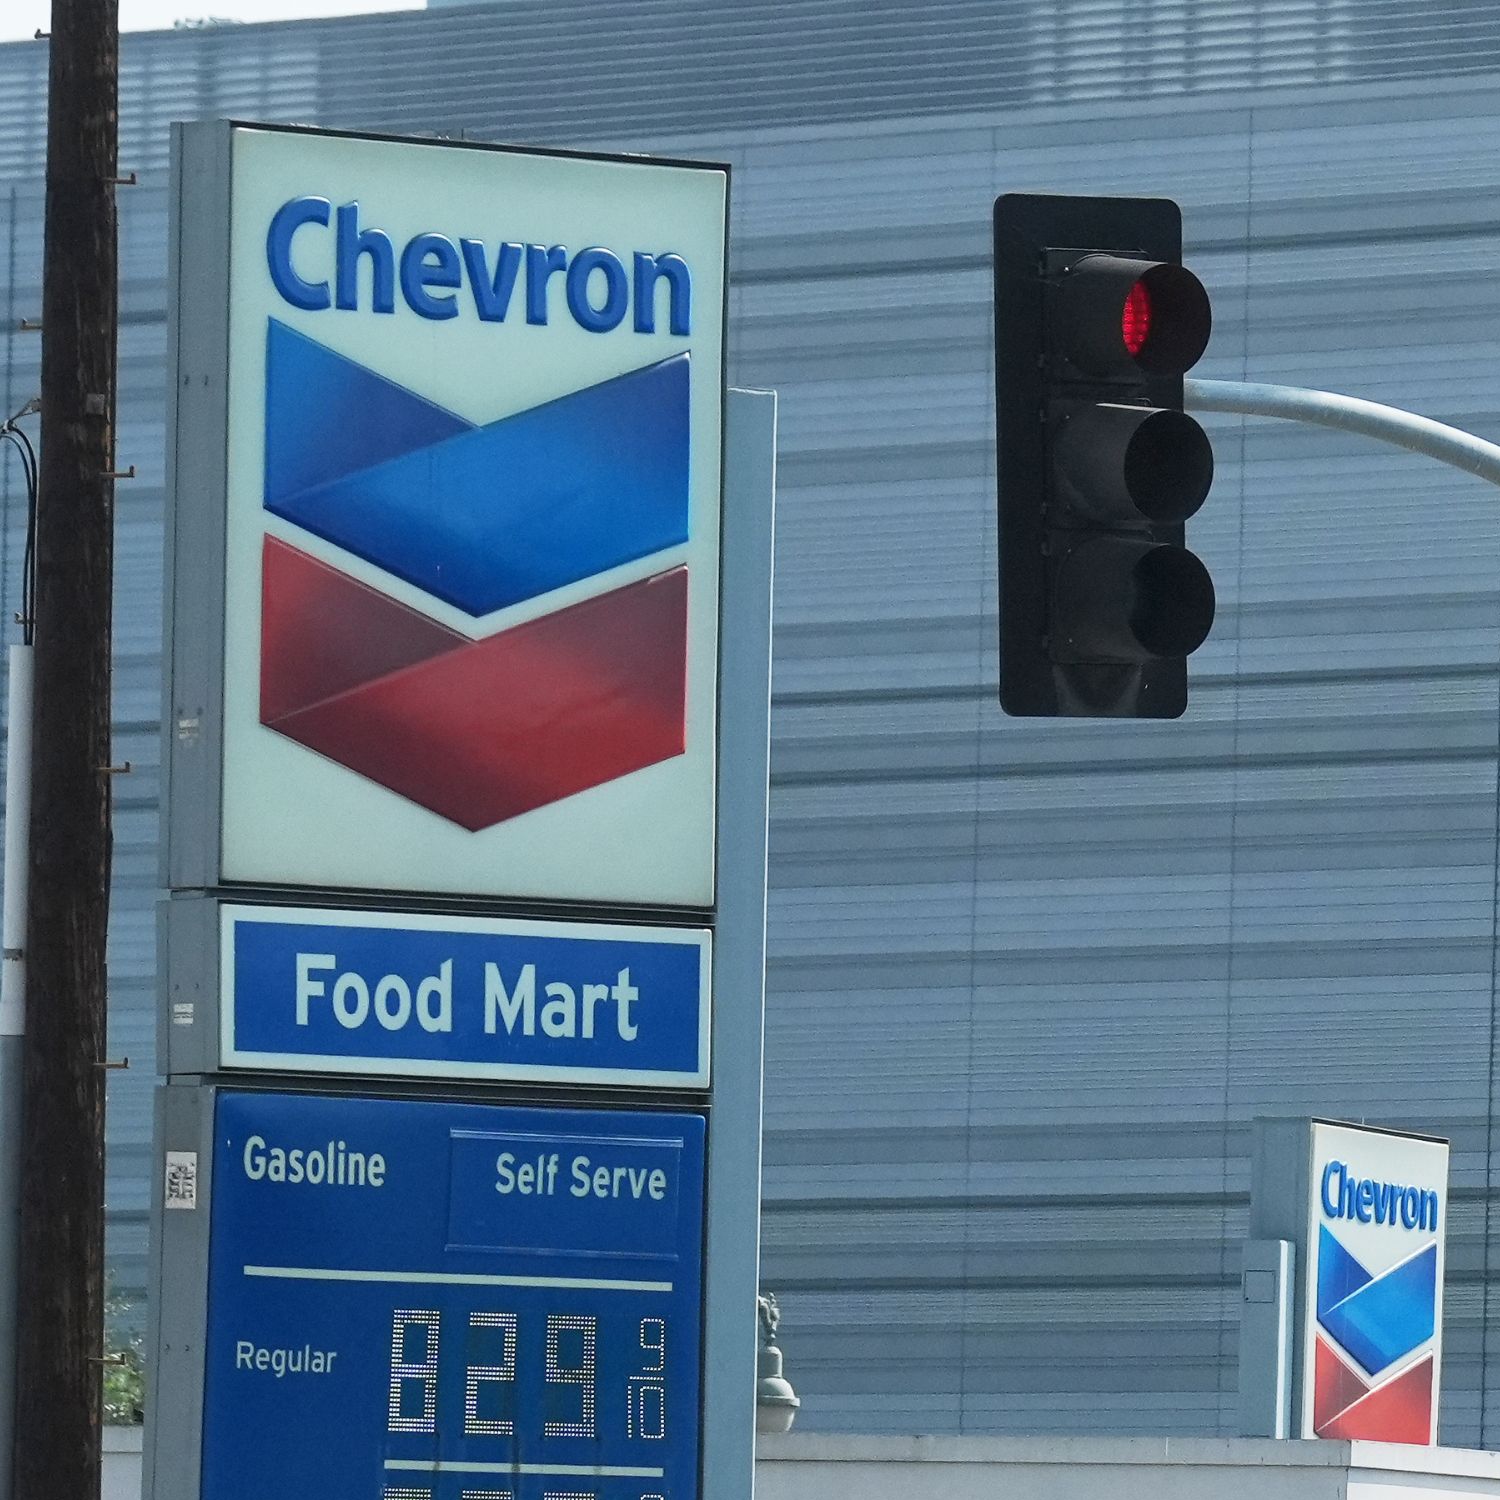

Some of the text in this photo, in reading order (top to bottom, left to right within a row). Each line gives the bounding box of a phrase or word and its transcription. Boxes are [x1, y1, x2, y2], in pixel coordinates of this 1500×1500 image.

[266, 195, 690, 336] Chevron
[295, 952, 639, 1042] Food Mart
[244, 1135, 385, 1188] Gasoline
[495, 1152, 559, 1196] Self
[571, 1157, 667, 1200] Serve
[1321, 1160, 1438, 1232] Chevron
[235, 1309, 597, 1438] Regular 829
